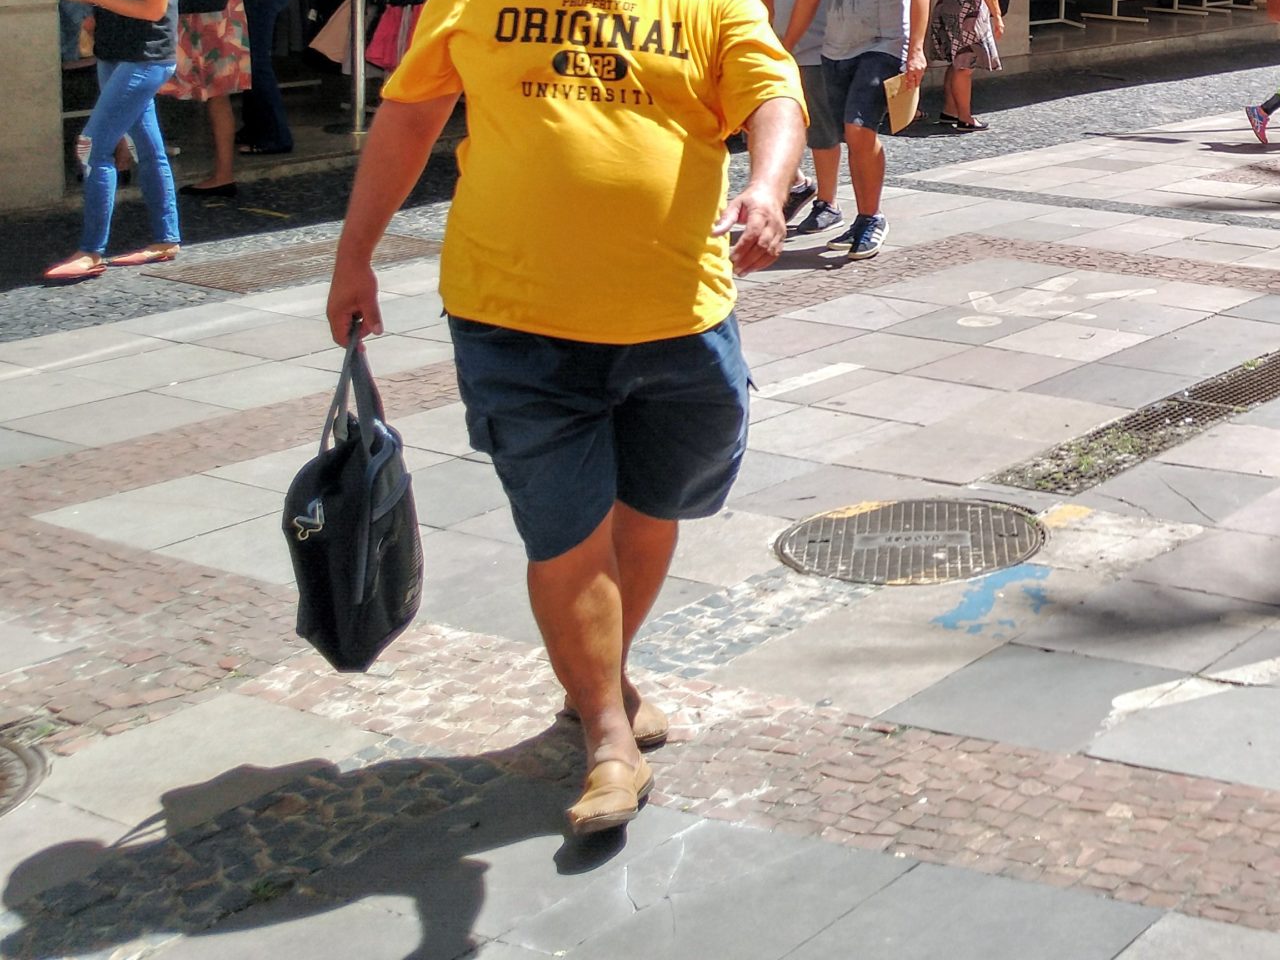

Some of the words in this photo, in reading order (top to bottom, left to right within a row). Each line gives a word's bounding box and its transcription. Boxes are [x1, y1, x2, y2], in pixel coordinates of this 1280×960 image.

[622, 1, 638, 12] OF
[494, 7, 690, 60] ORIGINAL
[521, 81, 654, 105] UNIVERSITY
